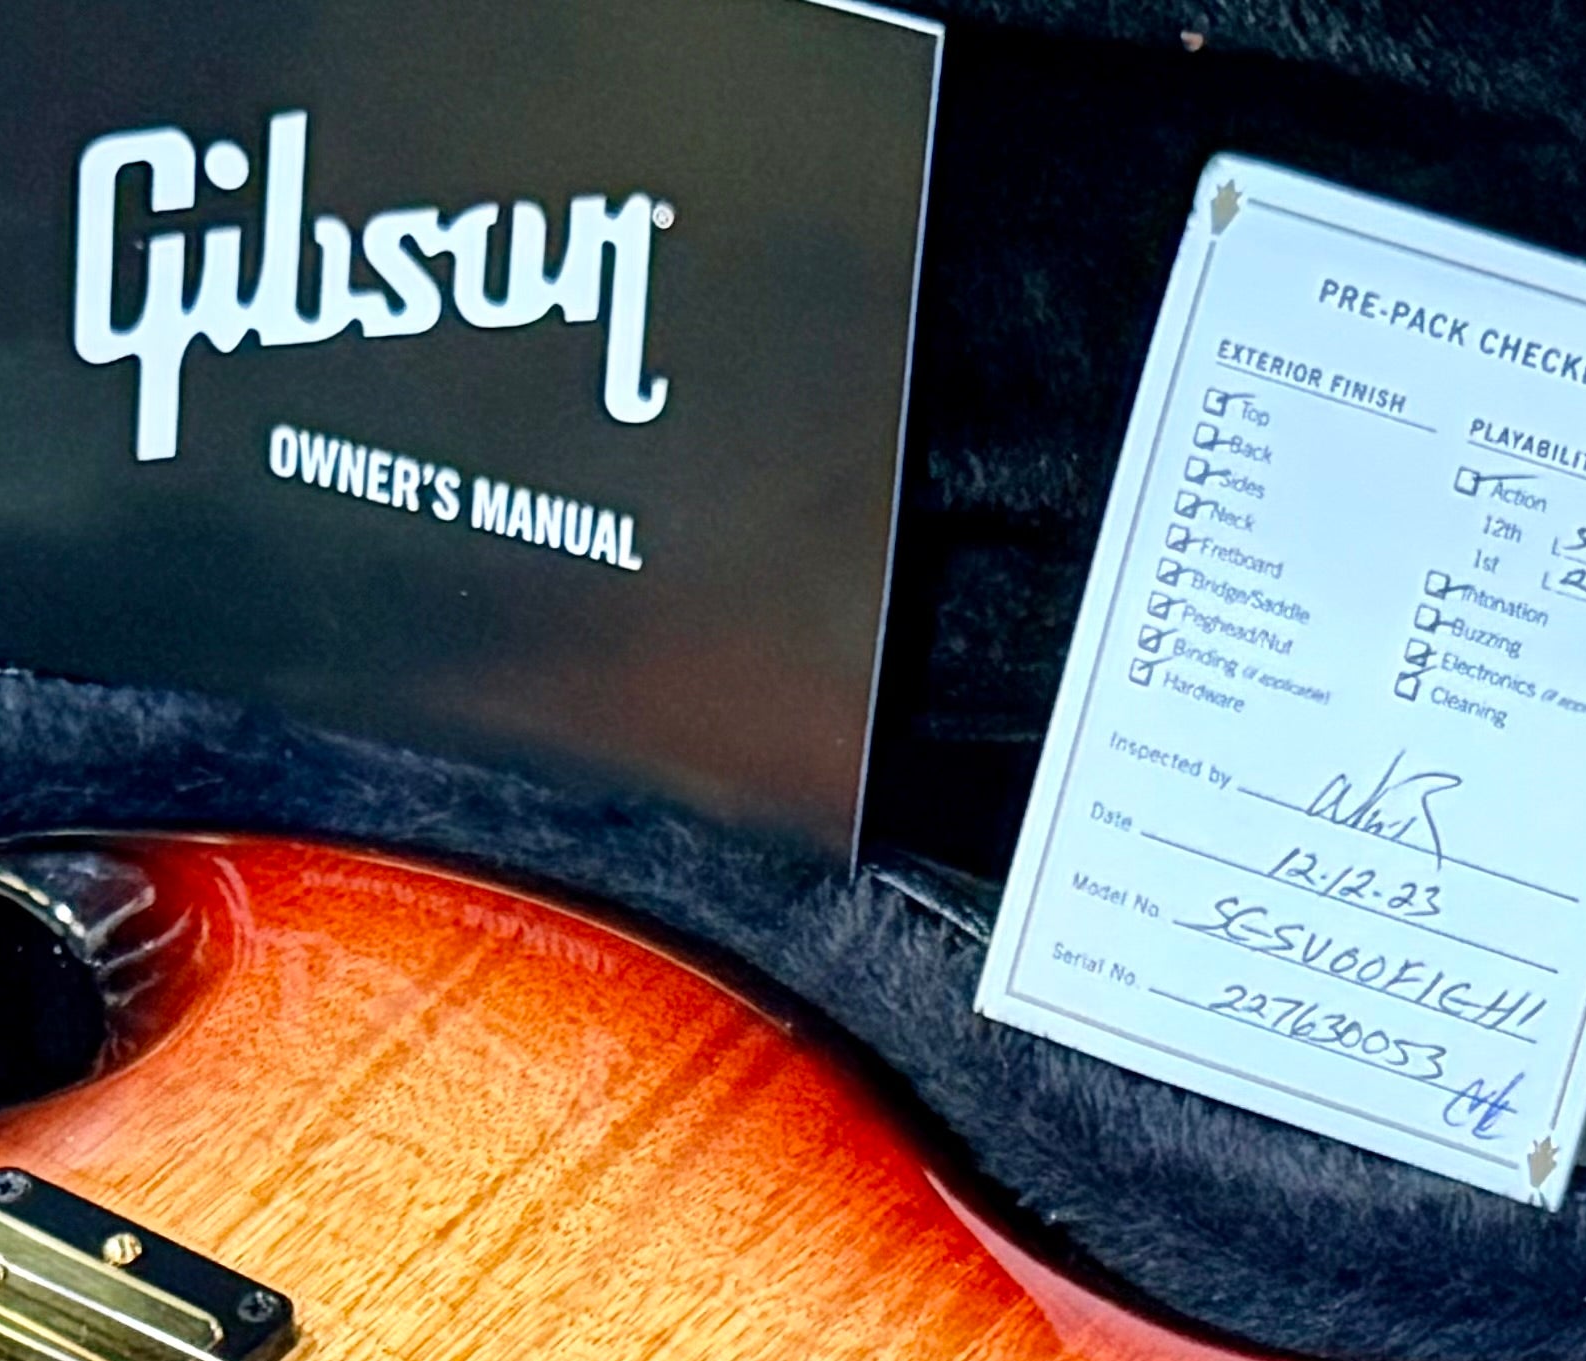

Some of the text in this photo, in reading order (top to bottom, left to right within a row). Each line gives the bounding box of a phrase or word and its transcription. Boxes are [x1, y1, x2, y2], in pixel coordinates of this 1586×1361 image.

[74, 109, 670, 462] Gibson
[1319, 279, 1469, 346] PRE-PACK
[1216, 339, 1407, 413] EXTERIOR FINISH
[1242, 401, 1270, 427] Top
[1229, 435, 1272, 464] Back
[268, 423, 643, 573] OWNER'S MANUAL
[1219, 472, 1265, 499] Sides
[1490, 481, 1548, 513] Action
[1210, 502, 1255, 532] Neck
[1482, 514, 1523, 543] 12th
[1200, 537, 1284, 579] Fretboard
[1473, 549, 1500, 574] 1st
[1191, 571, 1311, 624] Bridge/Saddle
[1461, 587, 1549, 628] Intonation
[1182, 605, 1294, 655] Peghead/Nut
[1452, 617, 1523, 659] Buzzing
[1173, 638, 1238, 678] Binding
[1441, 652, 1536, 698] Electronics
[1163, 671, 1245, 712] Hardware
[1431, 686, 1508, 729] Cleaning
[1110, 731, 1232, 791] Inspected by
[1089, 801, 1133, 832] Date
[1072, 871, 1128, 906] Model
[1052, 941, 1105, 974] Serial
[1209, 984, 1448, 1080] 227630053
